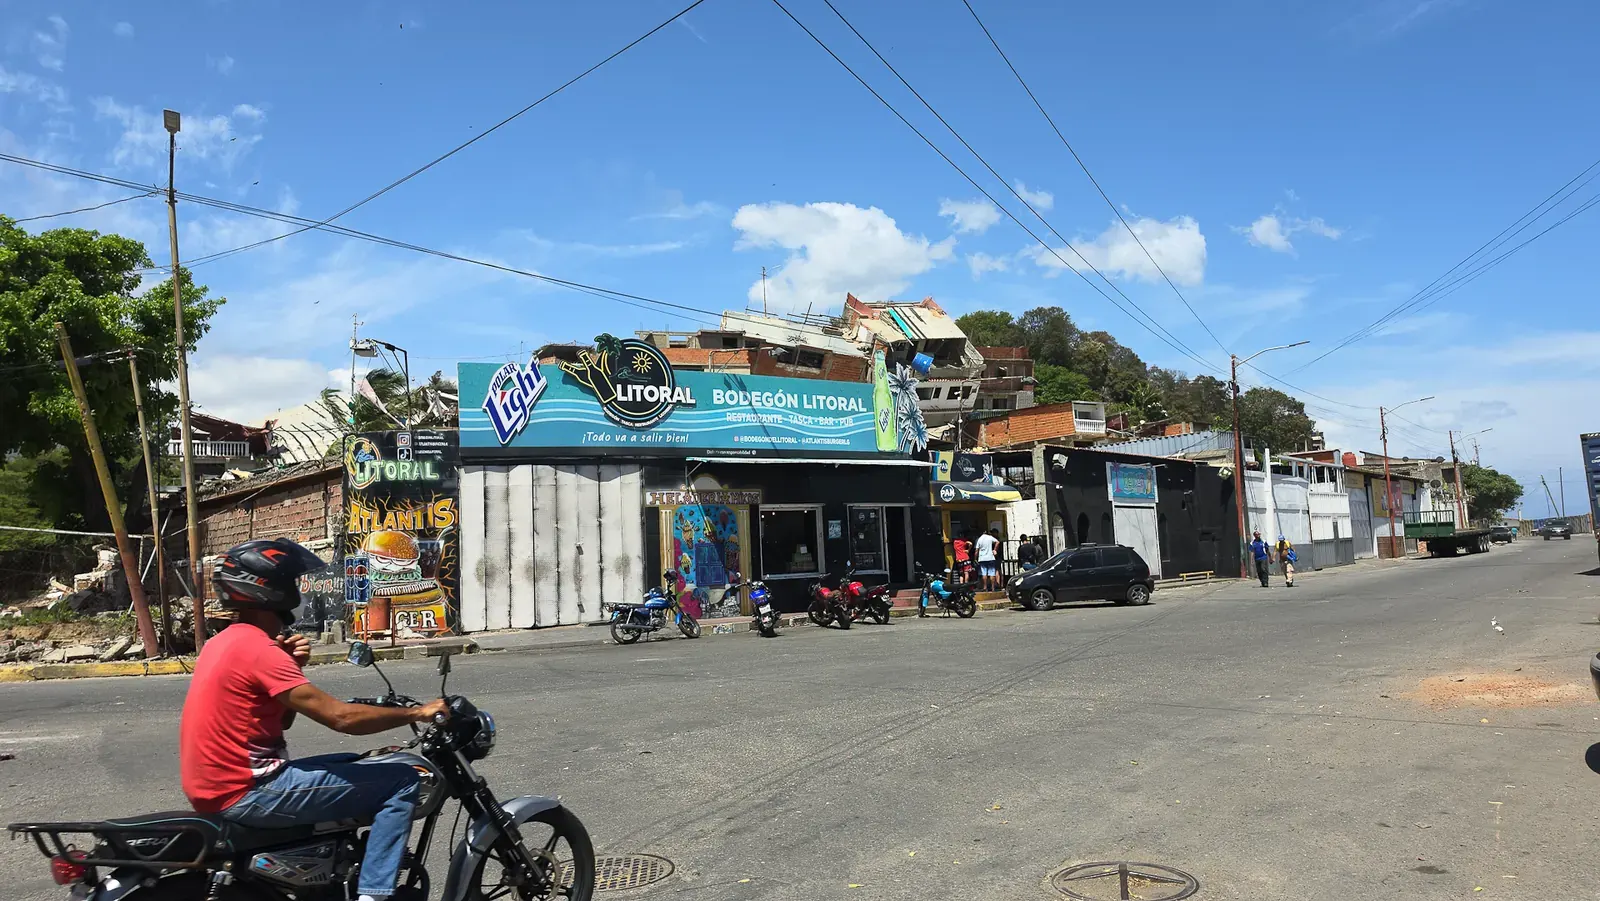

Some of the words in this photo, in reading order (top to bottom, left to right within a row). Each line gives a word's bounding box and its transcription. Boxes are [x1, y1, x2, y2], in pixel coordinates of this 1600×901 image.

[492, 363, 517, 397] POLAR
[485, 360, 542, 442] Light
[616, 384, 696, 404] LITORAL
[712, 388, 799, 409] BODEGÓN
[802, 394, 867, 412] LITORAL
[726, 412, 783, 424] RESTAURANTE
[788, 414, 813, 425] TASCA
[819, 416, 834, 426] BAR
[839, 417, 854, 427] PUB
[582, 431, 611, 444] ¡Todo
[615, 434, 627, 442] va
[640, 431, 662, 443] salir
[666, 432, 689, 443] bien!
[356, 461, 440, 482] LITORAL
[348, 498, 455, 533] ATLANTIS
